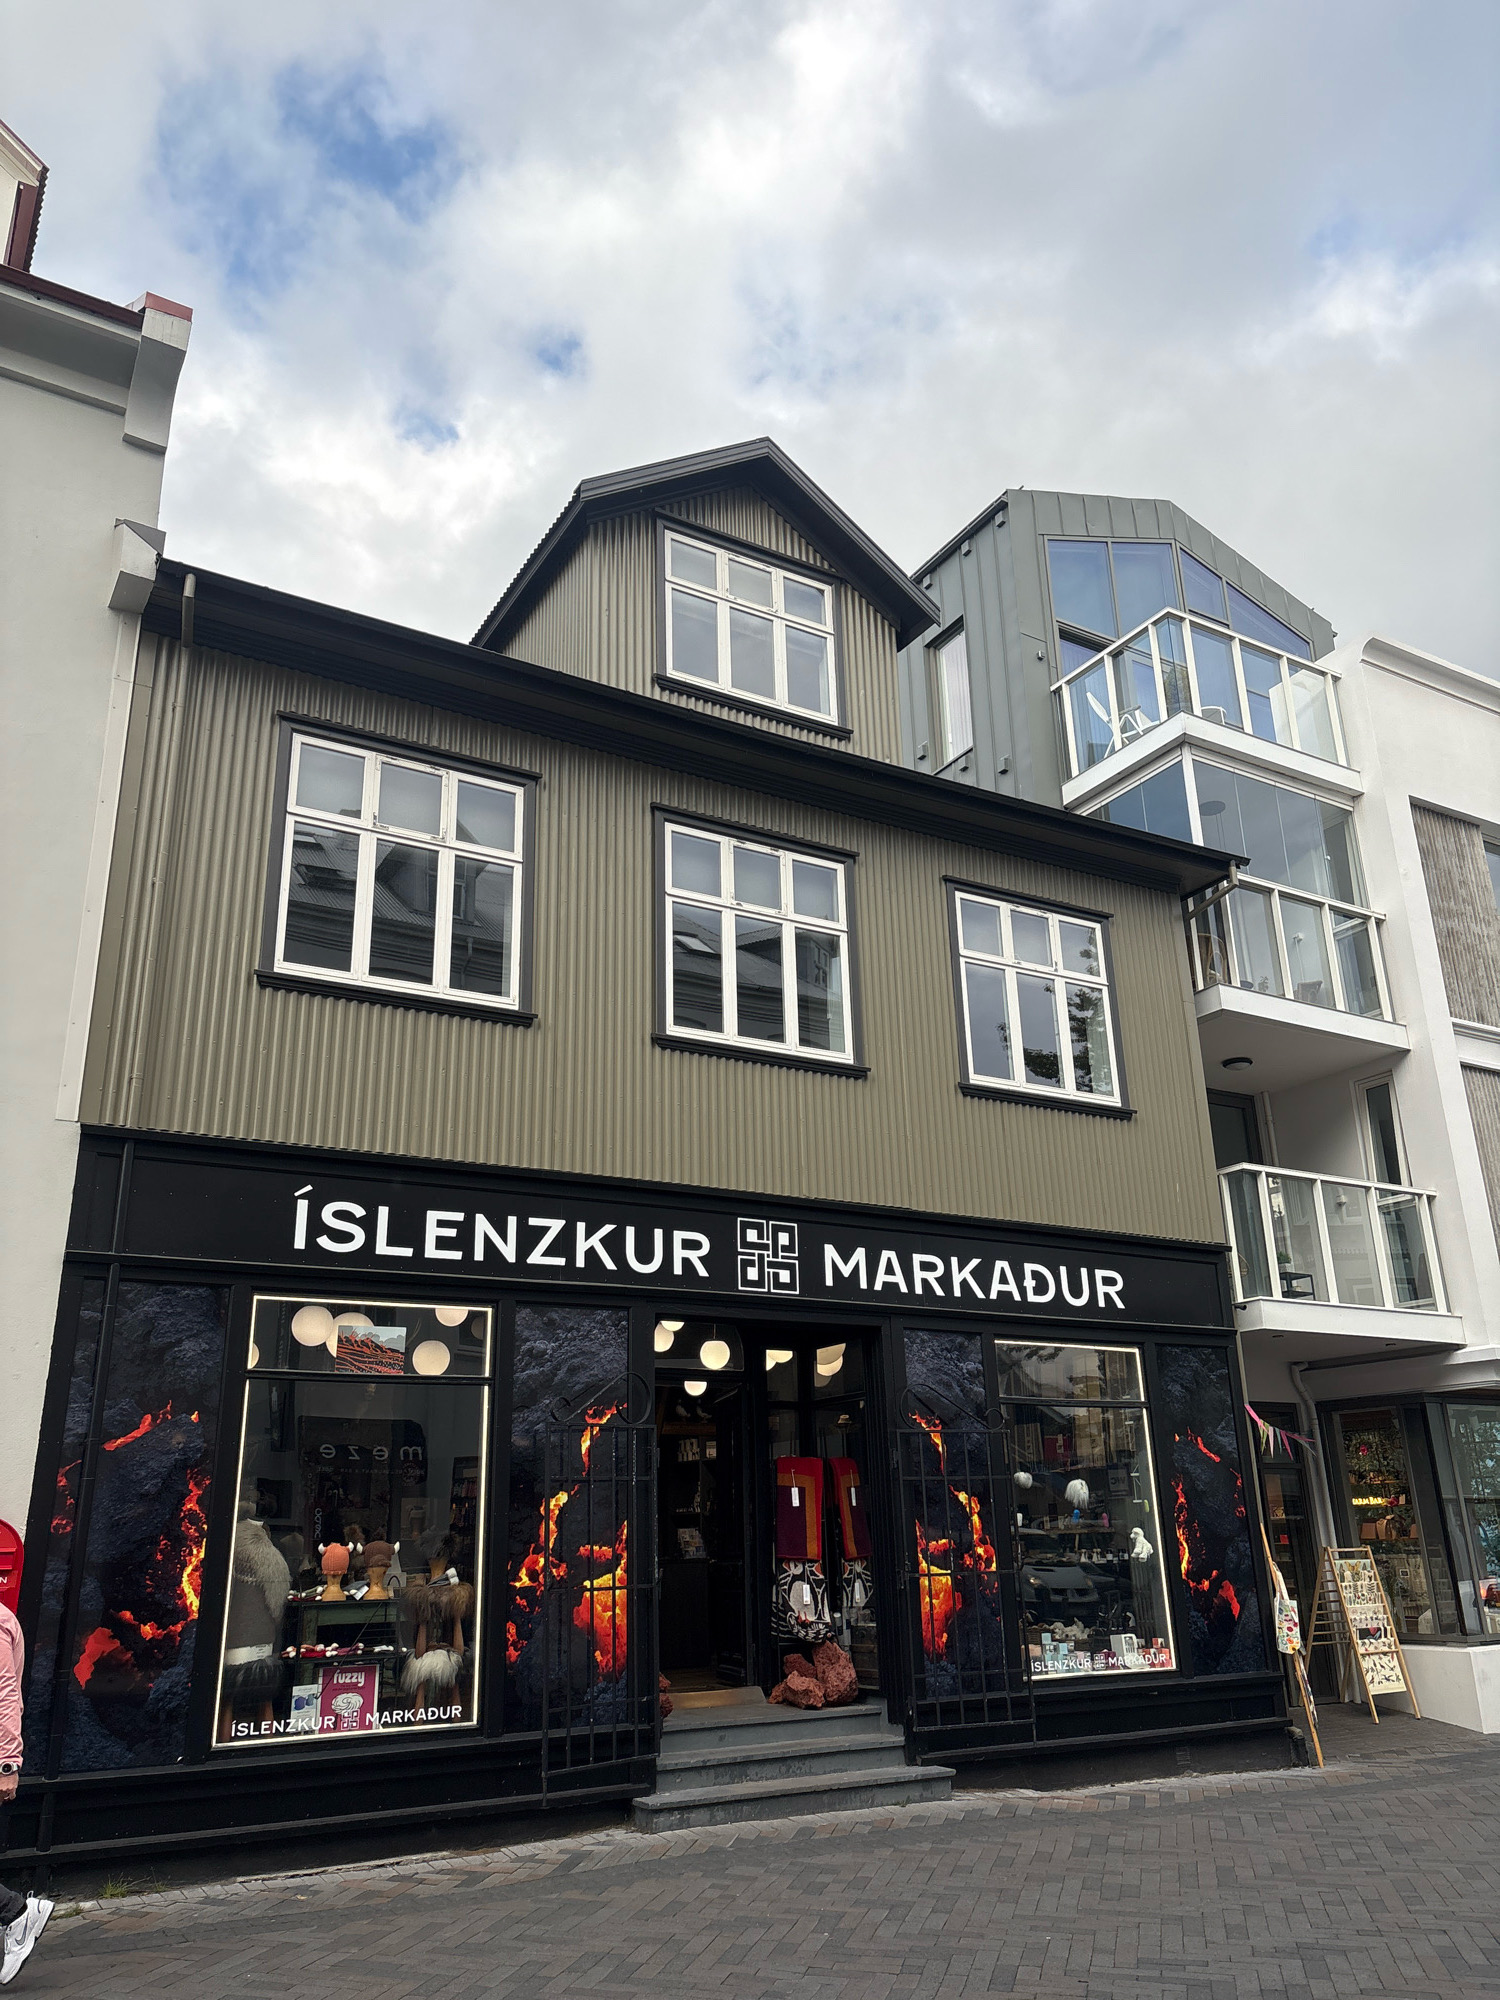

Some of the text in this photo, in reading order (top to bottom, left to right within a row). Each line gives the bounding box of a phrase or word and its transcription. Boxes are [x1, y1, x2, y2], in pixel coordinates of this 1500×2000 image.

[292, 1184, 1126, 1309] ÍSLENZKUR MARKAÐUR
[333, 1669, 365, 1687] fuzzy
[231, 1705, 462, 1737] ÍSLENZKUR MARKAÐUR
